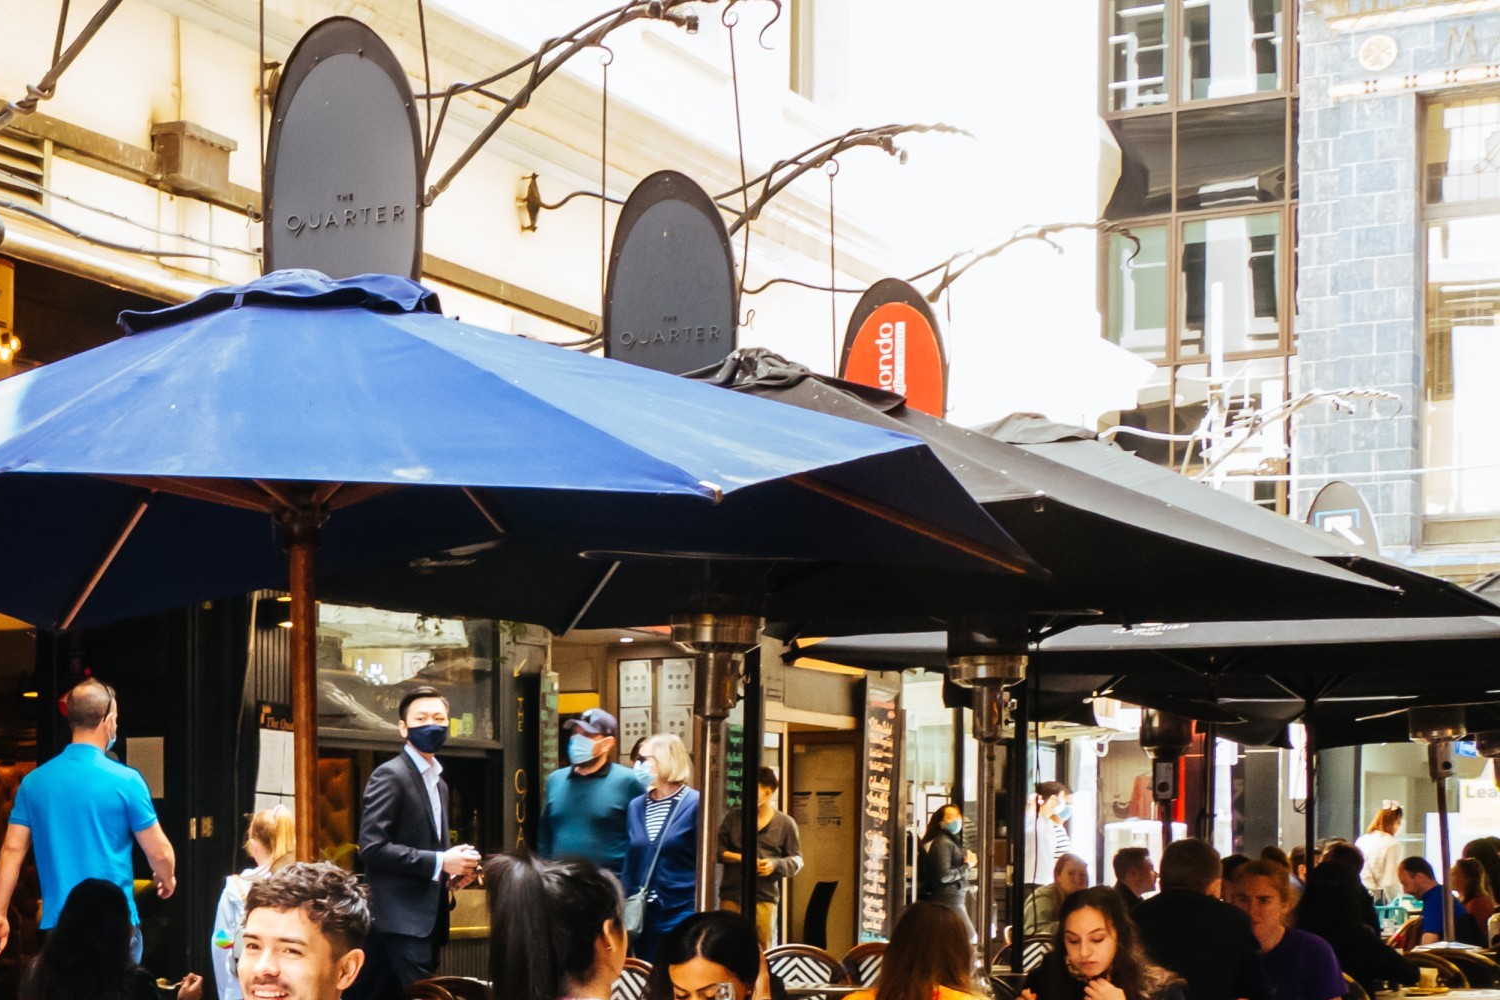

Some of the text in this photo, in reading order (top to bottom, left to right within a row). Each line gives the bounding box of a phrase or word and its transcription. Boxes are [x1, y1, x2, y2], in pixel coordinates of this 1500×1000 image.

[336, 193, 354, 202] THE
[286, 205, 405, 238] QUARTER
[662, 315, 677, 323] THE
[620, 325, 721, 350] QUARTER
[1464, 785, 1500, 799] Lea
